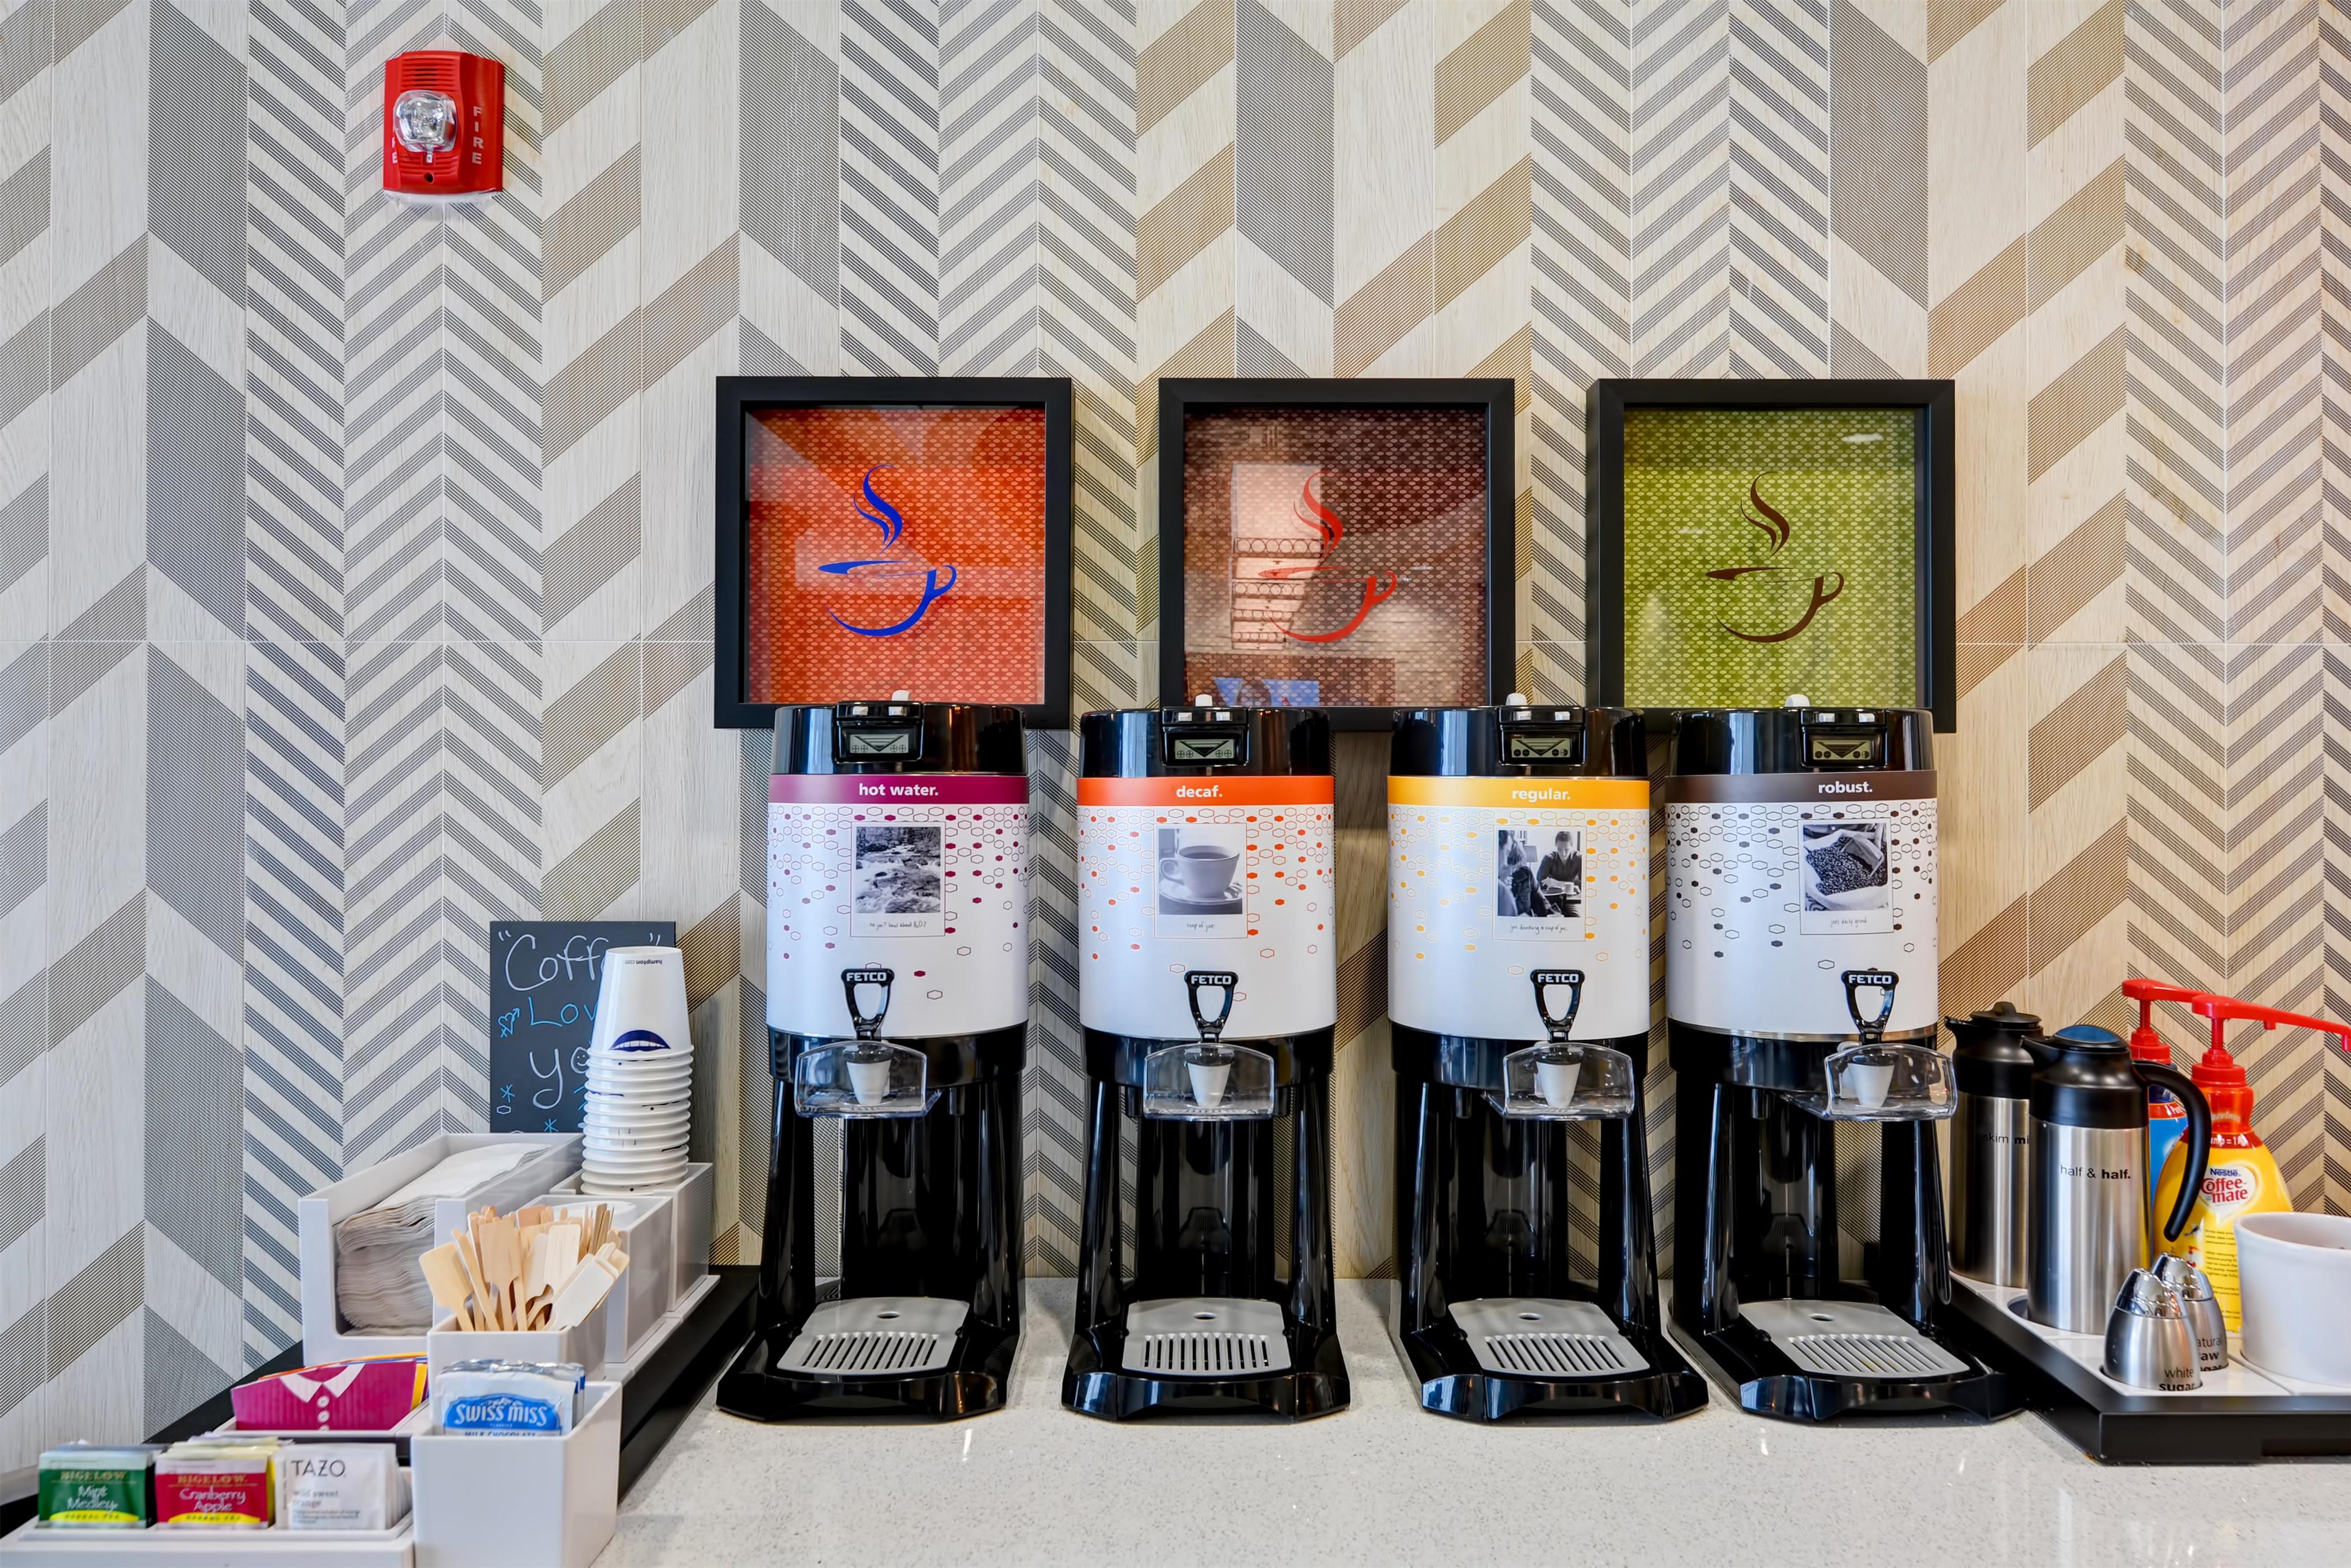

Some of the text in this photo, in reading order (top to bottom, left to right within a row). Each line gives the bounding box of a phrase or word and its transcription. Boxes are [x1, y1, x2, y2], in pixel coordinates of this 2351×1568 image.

[472, 106, 484, 164] FIRE
[859, 782, 939, 797] hot water.
[1176, 785, 1223, 798] decaf.
[1818, 780, 1872, 794] robust.
[1511, 787, 1571, 803] regular.
[1205, 923, 1214, 932] joe
[1854, 916, 1868, 928] grind
[1519, 923, 1540, 935] drinking
[846, 972, 886, 982] FETCO
[1191, 975, 1232, 985] FETCO
[1538, 972, 1579, 983] FETCO
[1848, 974, 1893, 985] FETCO
[528, 996, 598, 1027] Lov
[529, 1048, 589, 1110] yo
[1982, 1132, 2030, 1145] skim mi
[2060, 1165, 2131, 1180] half & half.
[2212, 1189, 2248, 1203] mate
[2196, 1334, 2223, 1347] atural
[2164, 1366, 2194, 1378] white
[60, 1471, 127, 1480] BIGELOW
[177, 1475, 246, 1484] BIGELOW
[78, 1485, 108, 1498] Mint
[179, 1485, 246, 1505] Cranberry
[67, 1496, 118, 1514] Medley
[193, 1500, 233, 1517] Apple
